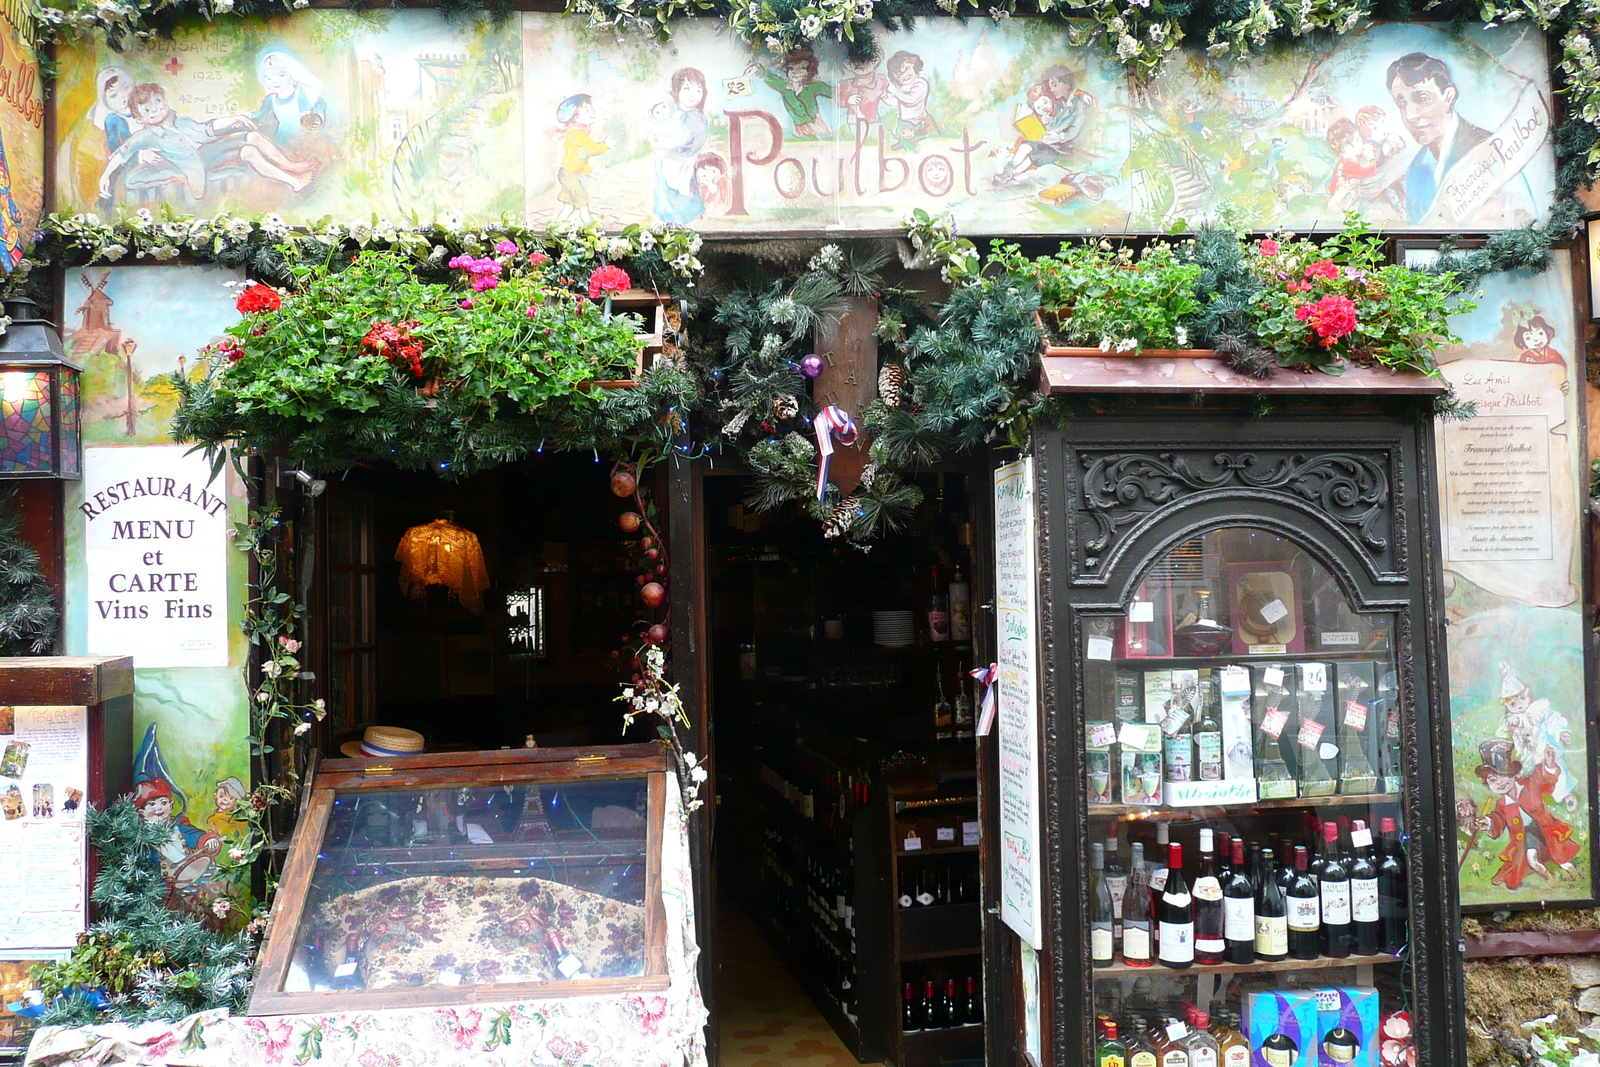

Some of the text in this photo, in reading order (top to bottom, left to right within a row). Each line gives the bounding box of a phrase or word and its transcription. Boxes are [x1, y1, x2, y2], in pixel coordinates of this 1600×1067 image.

[1489, 106, 1543, 166] Poulbot
[723, 108, 987, 217] Poulbot
[1484, 371, 1511, 385] Amis
[1502, 392, 1543, 408] Poulbot
[79, 477, 228, 521] RESTAURANT
[111, 520, 195, 540] MENU
[142, 549, 164, 566] et
[108, 572, 198, 593] CARTE
[95, 598, 213, 619] Vins Fins
[1178, 783, 1255, 801] Absinthe
